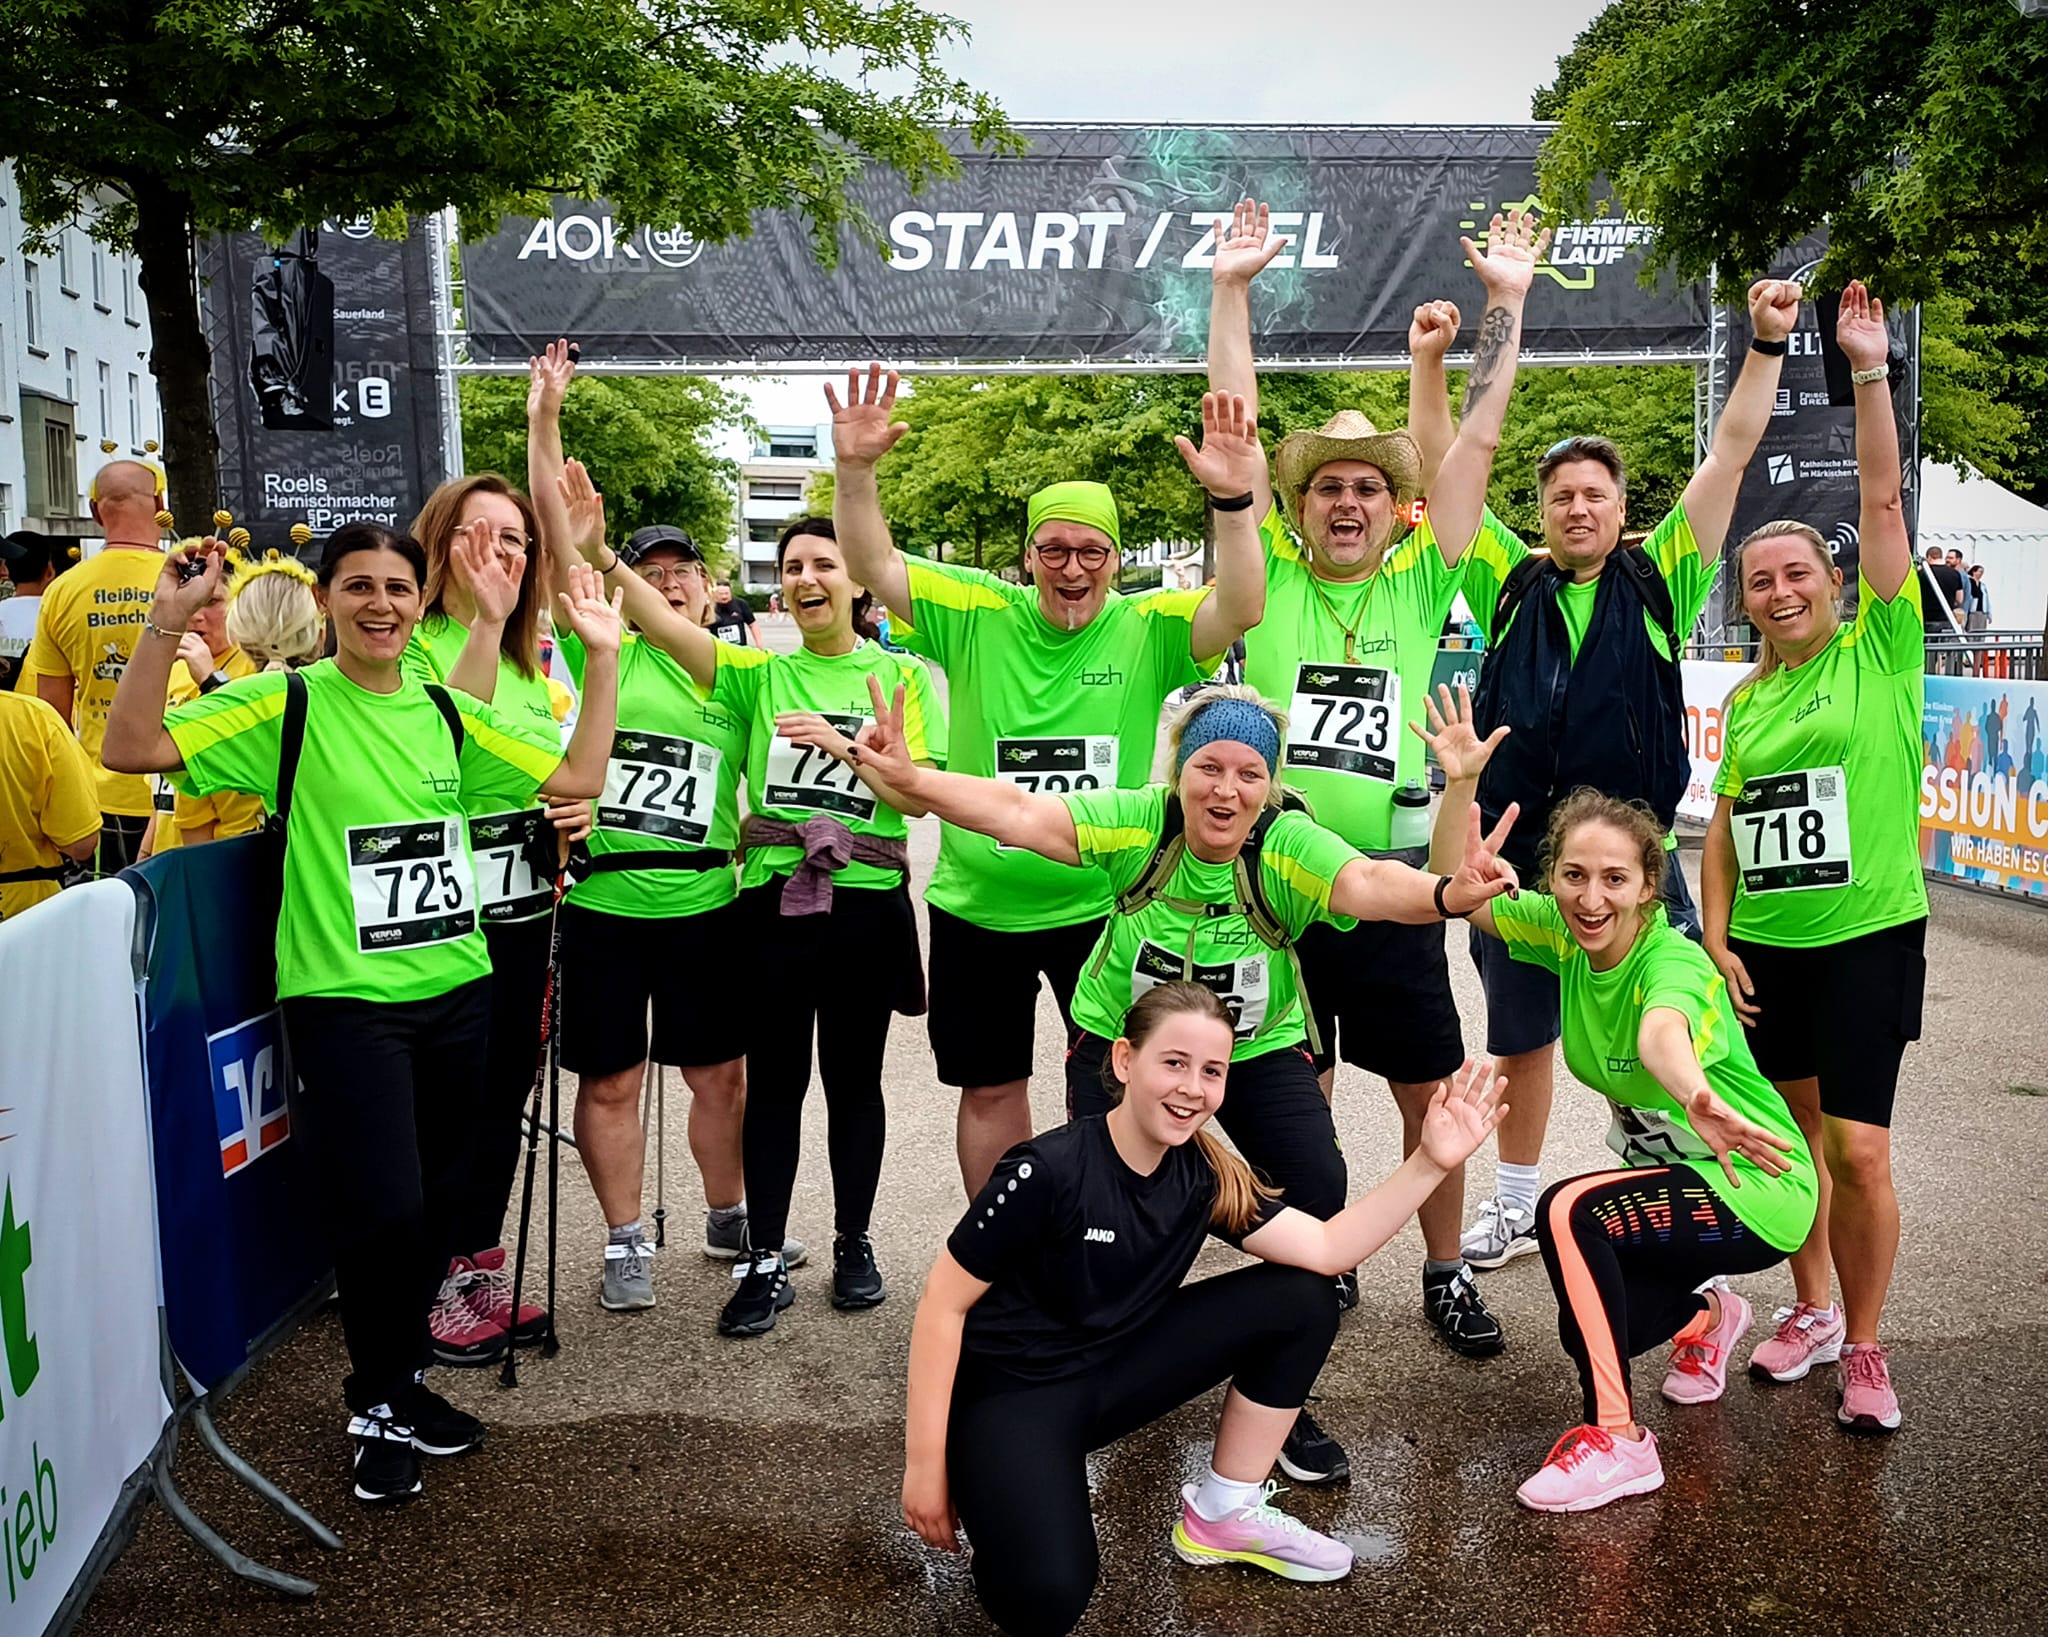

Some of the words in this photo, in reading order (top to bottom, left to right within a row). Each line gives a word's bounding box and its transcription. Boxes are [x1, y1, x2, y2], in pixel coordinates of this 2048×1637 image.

[517, 214, 641, 261] AOK
[888, 211, 1126, 271] START
[1135, 211, 1173, 269] /
[1182, 211, 1339, 269] ZEL
[1550, 246, 1626, 265] LAUF
[333, 308, 385, 320] Sauerland
[264, 473, 328, 493] Roels
[1842, 459, 1858, 468] Klin
[265, 493, 397, 509] Harnischmacher
[94, 586, 156, 604] fleißig
[87, 609, 146, 628] Biench
[1310, 698, 1389, 752] 723
[618, 763, 697, 817] 724
[1919, 764, 2018, 834] SSION
[2027, 779, 2048, 839] C
[1744, 809, 1826, 865] 718
[1951, 835, 1973, 858] WIR
[1976, 841, 2020, 871] HABEN
[2023, 850, 2040, 874] ES
[374, 860, 463, 919] 725
[1083, 1227, 1116, 1243] JAKO
[0, 1172, 41, 1398] t
[0, 1439, 58, 1604] ieb
